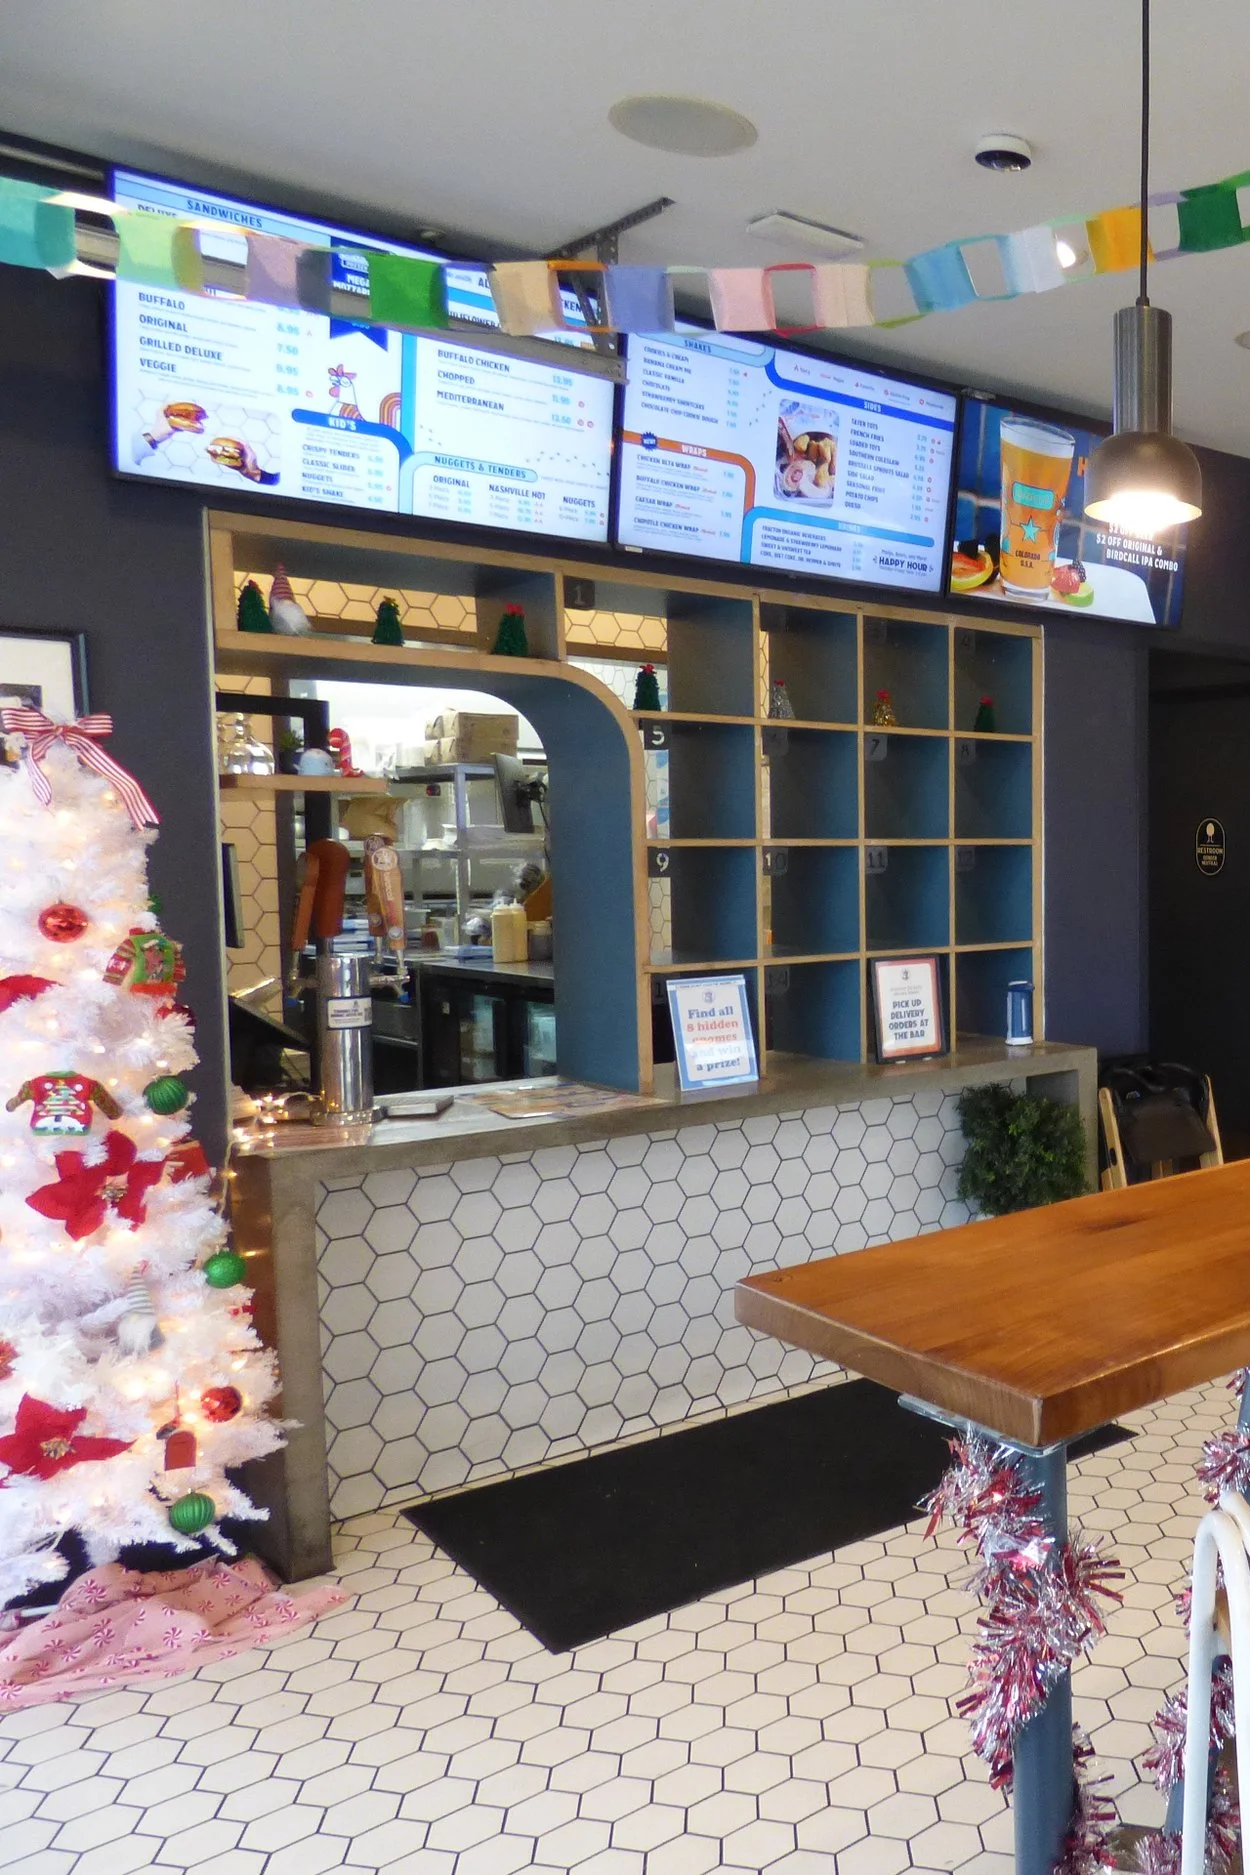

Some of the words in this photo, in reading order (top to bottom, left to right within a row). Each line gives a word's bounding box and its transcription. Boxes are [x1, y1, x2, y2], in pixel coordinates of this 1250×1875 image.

[187, 200, 263, 228] SANDWICHES
[138, 292, 185, 311] BUFFALO
[139, 314, 188, 333] ORIGINAL
[139, 336, 182, 353] GRILLED
[184, 346, 223, 361] DELUXE
[684, 340, 712, 353] SHAKES
[139, 357, 177, 373] VEGGIE
[437, 349, 474, 365] BUFFALO
[475, 359, 510, 373] CHICKEN
[643, 357, 665, 368] BANANA
[665, 363, 683, 373] CREAM
[437, 370, 475, 385] CHOPPED
[642, 368, 663, 378] CLASSIC
[664, 373, 685, 384] VANILLA
[642, 379, 671, 392] CHOCOLATE
[436, 390, 505, 411] MEDITERRANEAN
[642, 391, 676, 404] STRAWBERRY
[641, 401, 669, 413] CHOCOLATE
[863, 400, 882, 414] SIDES
[328, 417, 357, 431] KID'S
[866, 421, 879, 431] TOTS
[850, 428, 870, 440] FRENCH
[870, 433, 885, 442] FRIES
[302, 444, 327, 453] CRISPY
[329, 448, 360, 460] TENDERS
[681, 444, 707, 457] WRAPS
[849, 439, 869, 449] LOADED
[869, 443, 881, 452] TOTS
[636, 454, 661, 465] CHICKEN
[675, 461, 691, 470] WRAP
[848, 449, 875, 461] SOUTHERN
[874, 456, 900, 466] COLESLAW
[302, 458, 329, 468] CLASSIC
[331, 462, 356, 473] SLIDER
[434, 455, 475, 470] NUGGETS
[478, 463, 485, 472] &
[488, 464, 527, 479] TENDERS
[847, 460, 872, 471] BRUSSELS
[873, 465, 894, 476] SPROUTS
[895, 470, 910, 479] SALAD
[301, 472, 333, 483] NUGGETS
[432, 475, 470, 488] ORIGINAL
[636, 474, 660, 485] BUFFALO
[661, 479, 684, 489] CHICKEN
[684, 483, 701, 492] WRAP
[859, 472, 875, 481] SALAD
[488, 484, 529, 498] NASHVILLE
[531, 491, 546, 501] HOT
[846, 480, 871, 491] SEASONAL
[562, 496, 596, 509] NUGGETS
[635, 495, 656, 505] CAESAR
[656, 499, 673, 508] WRAP
[845, 490, 864, 500] POTATO
[864, 494, 879, 503] CHIPS
[634, 516, 659, 527] CHIPOTLE
[659, 521, 683, 530] CHICKEN
[683, 524, 700, 533] WRAP
[761, 534, 785, 543] LEMONADE
[790, 538, 819, 549] STRAWBERRY
[819, 543, 842, 552] LEMONADE
[761, 541, 776, 550] SWEET
[1096, 533, 1106, 545] $2
[1107, 535, 1121, 547] OFF
[1122, 539, 1156, 555] ORIGINAL
[1156, 545, 1163, 556] &
[1015, 549, 1041, 560] COLORADO
[1106, 548, 1140, 565] BIRDCALL
[1141, 555, 1153, 568] IPA
[1154, 557, 1179, 572] COMBO
[879, 556, 905, 569] HAPPY
[906, 561, 928, 572] HOUR
[651, 725, 665, 745] 5
[868, 738, 880, 755] 7
[656, 852, 670, 872] 9
[892, 1000, 910, 1009] PICK
[911, 999, 922, 1007] UP
[688, 1008, 715, 1020] Find
[719, 1006, 734, 1016] all
[890, 1008, 925, 1020] DELIVERY
[697, 1019, 739, 1031] hidden
[888, 1020, 918, 1031] ORDERS
[919, 1019, 929, 1027] AT
[894, 1031, 908, 1041] THE
[909, 1029, 925, 1039] BAR
[707, 1058, 740, 1072] prize!
